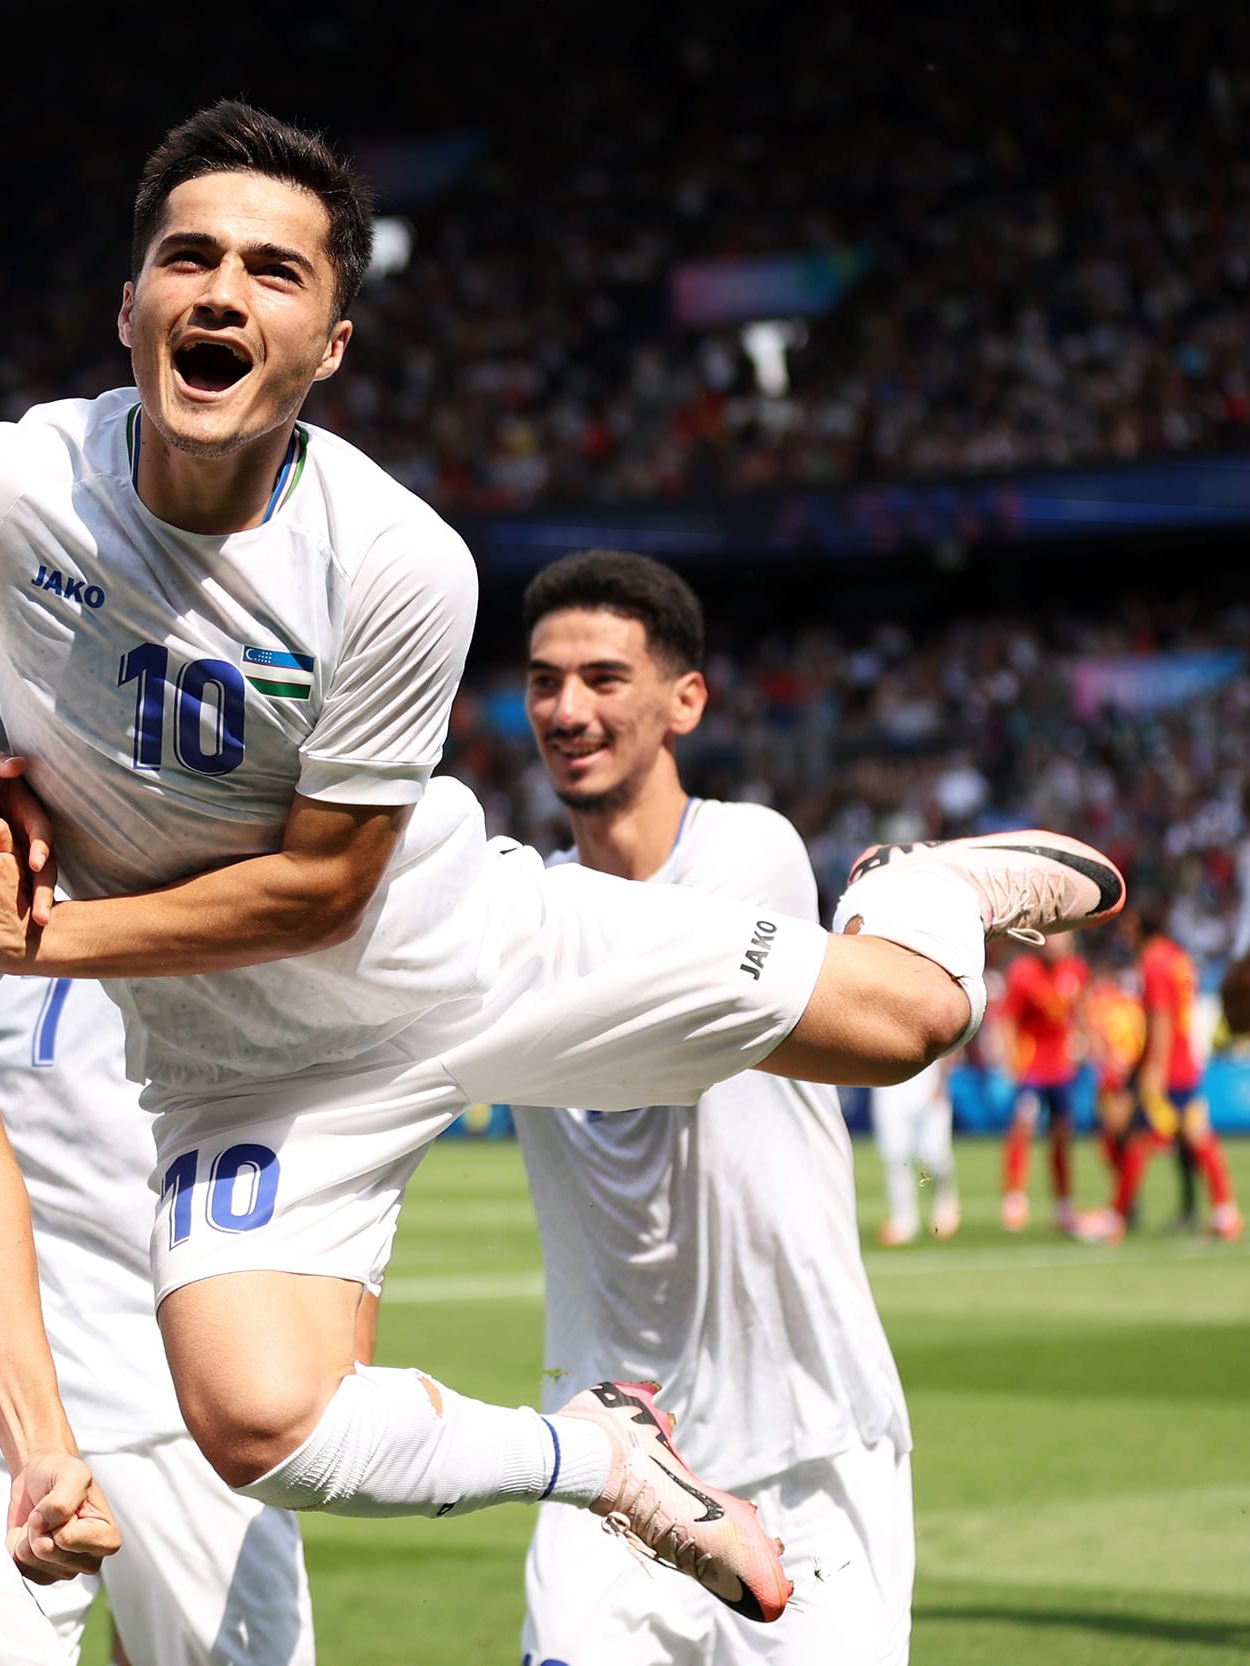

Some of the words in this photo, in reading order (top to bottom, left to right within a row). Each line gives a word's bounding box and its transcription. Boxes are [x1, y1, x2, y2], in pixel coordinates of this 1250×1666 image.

[30, 565, 105, 609] JAKO
[117, 642, 245, 776] 10
[740, 920, 777, 981] JAKO
[160, 1143, 281, 1251] 10
